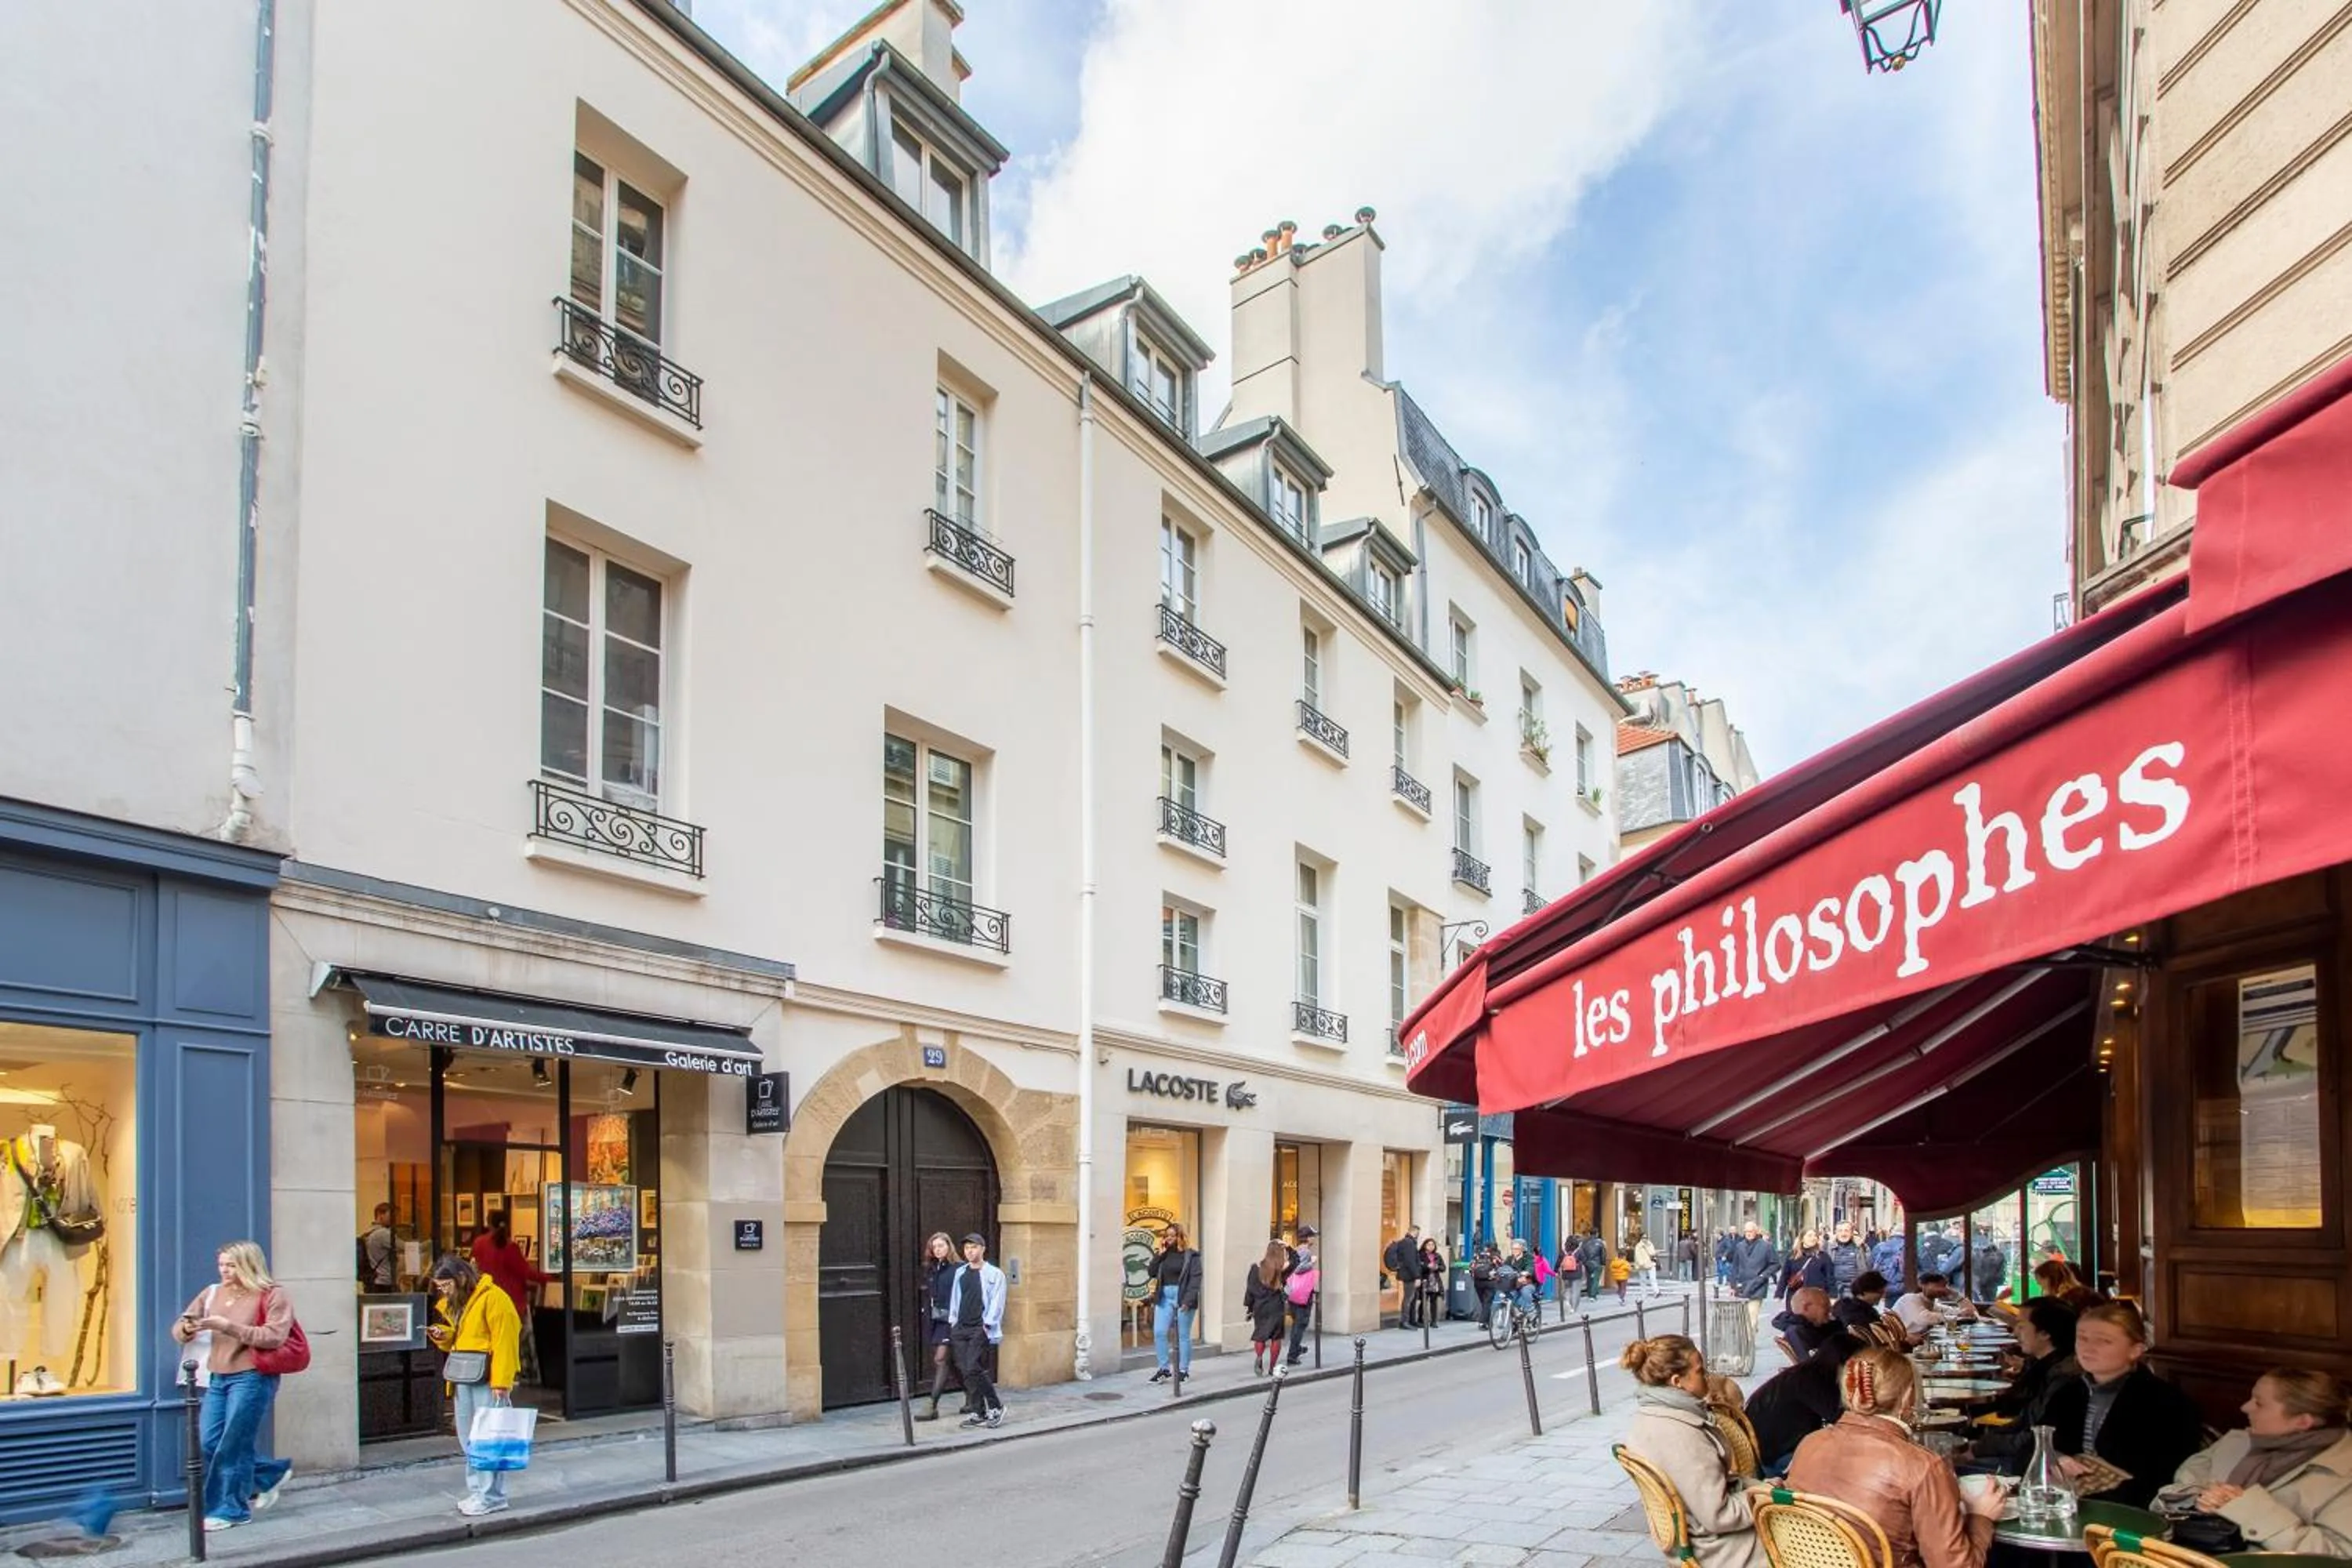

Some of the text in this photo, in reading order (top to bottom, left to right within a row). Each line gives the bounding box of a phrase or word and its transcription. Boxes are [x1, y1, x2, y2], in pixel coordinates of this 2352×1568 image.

[1571, 741, 2191, 1058] les philosophes
[471, 1026, 575, 1055] D'ARTISTES
[665, 1051, 753, 1076] Galerie d'art
[927, 1049, 943, 1064] 29
[1127, 1068, 1219, 1103] LACOSTE
